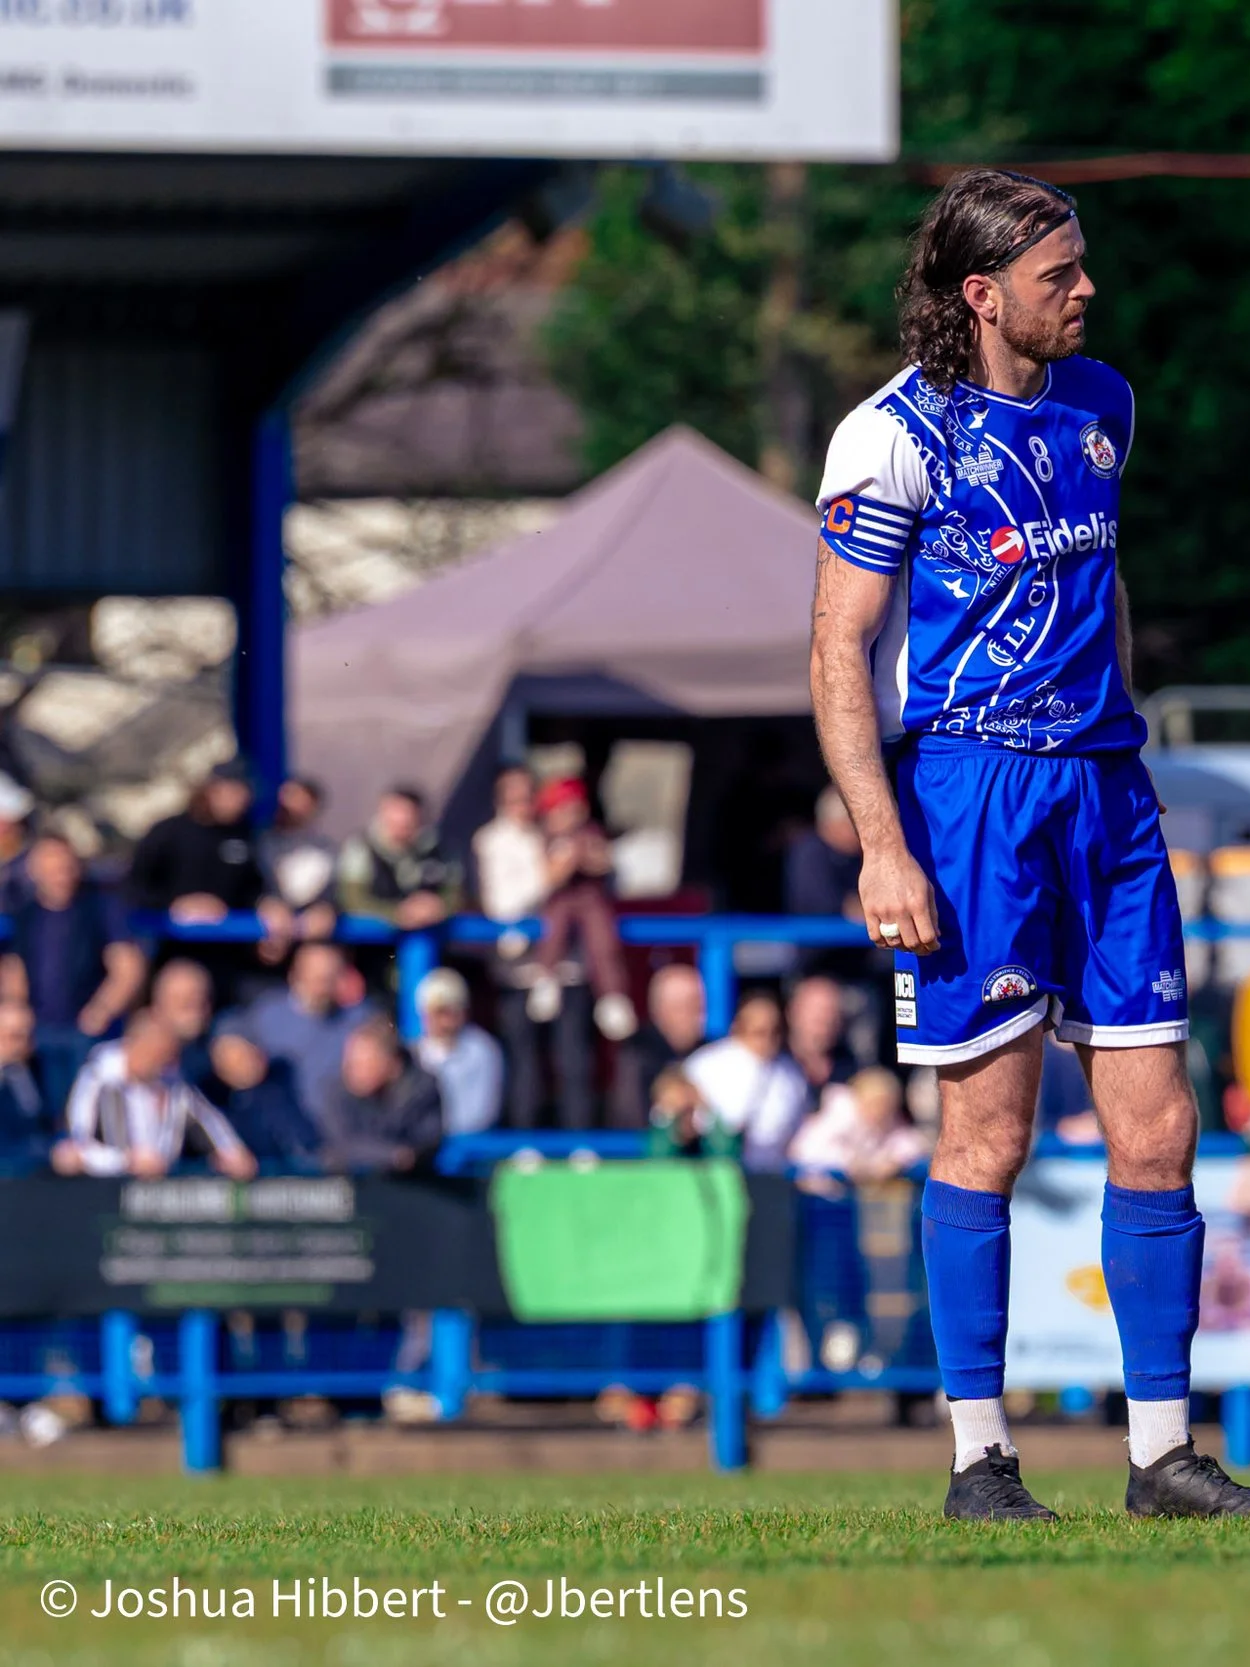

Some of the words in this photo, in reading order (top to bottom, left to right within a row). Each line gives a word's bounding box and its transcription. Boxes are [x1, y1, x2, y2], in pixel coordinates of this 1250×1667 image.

[957, 460, 1003, 478] MATCHWINNER
[1028, 435, 1053, 482] 8
[826, 498, 854, 534] C
[1022, 511, 1117, 560] Fidelis
